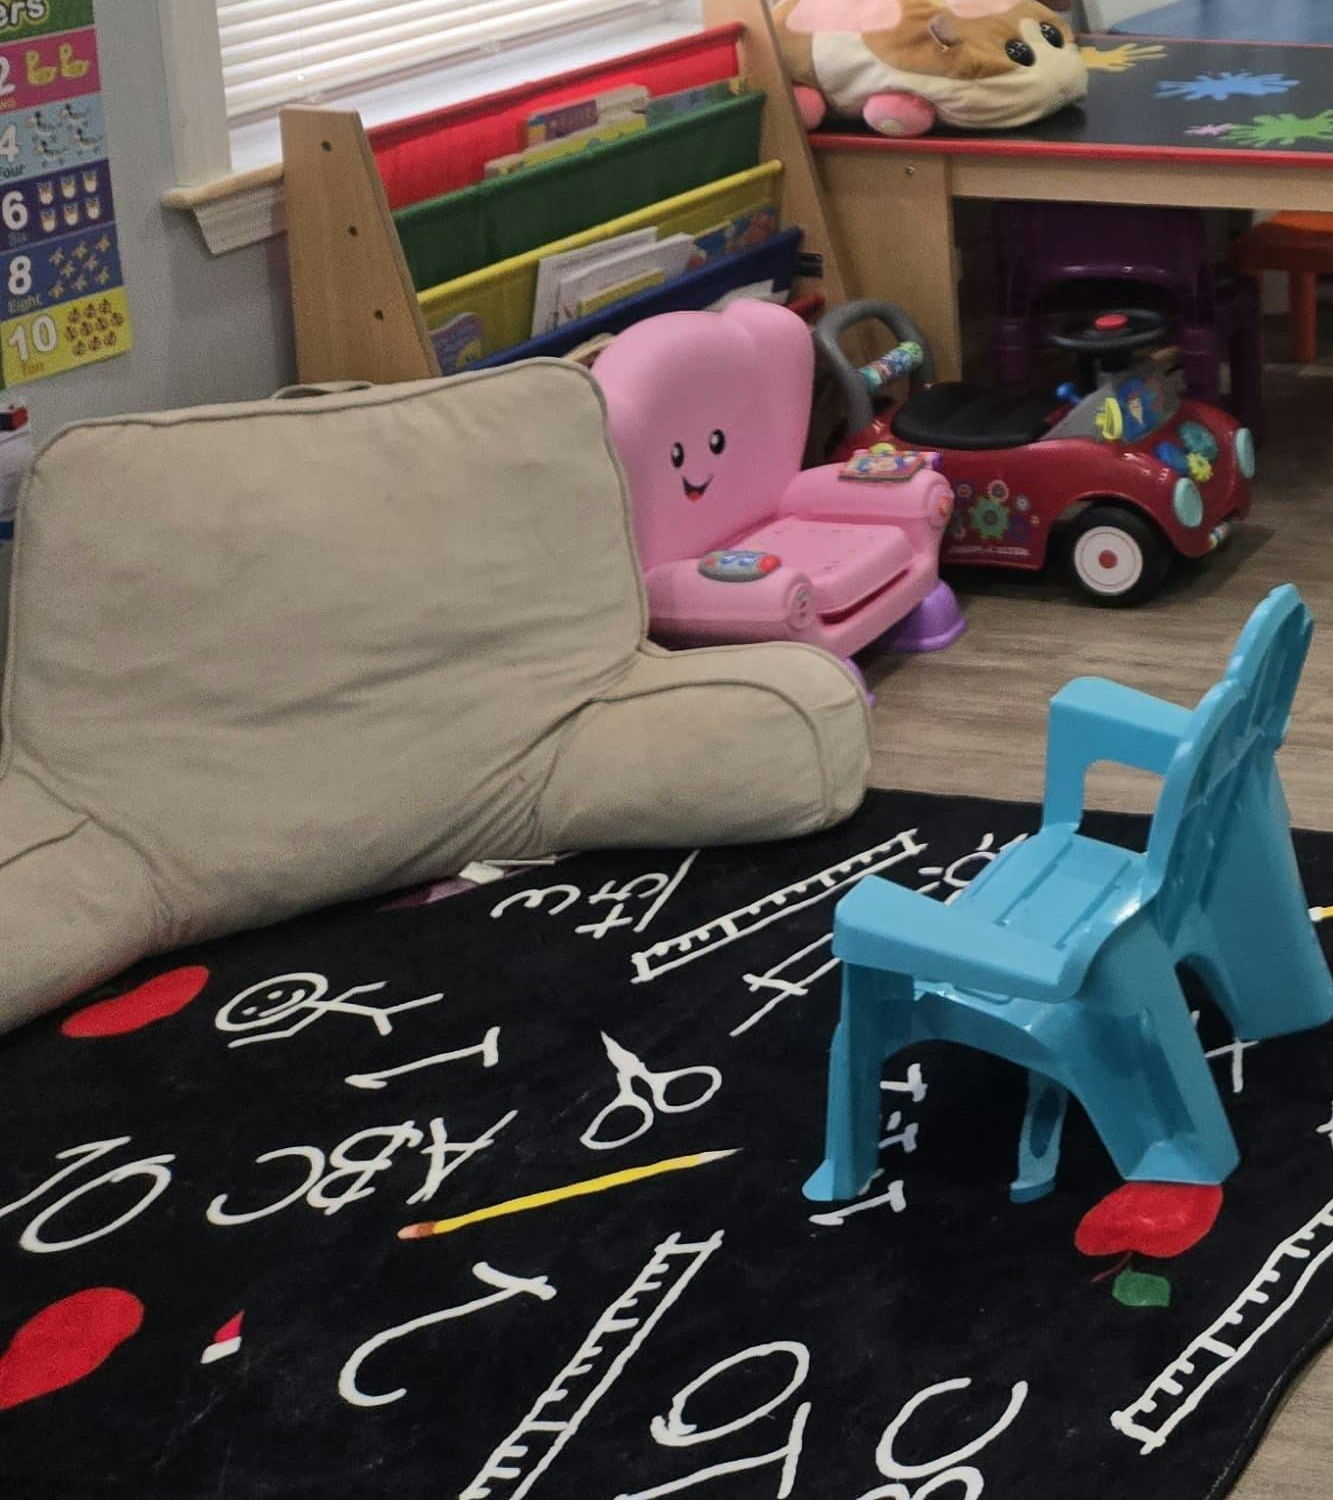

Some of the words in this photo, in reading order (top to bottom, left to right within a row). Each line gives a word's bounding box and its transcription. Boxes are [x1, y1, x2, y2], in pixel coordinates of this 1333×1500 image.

[0, 123, 20, 162] 4
[2, 191, 28, 230] 6
[8, 255, 32, 295] 8
[8, 315, 57, 361] 10
[206, 1109, 518, 1226] ABC
